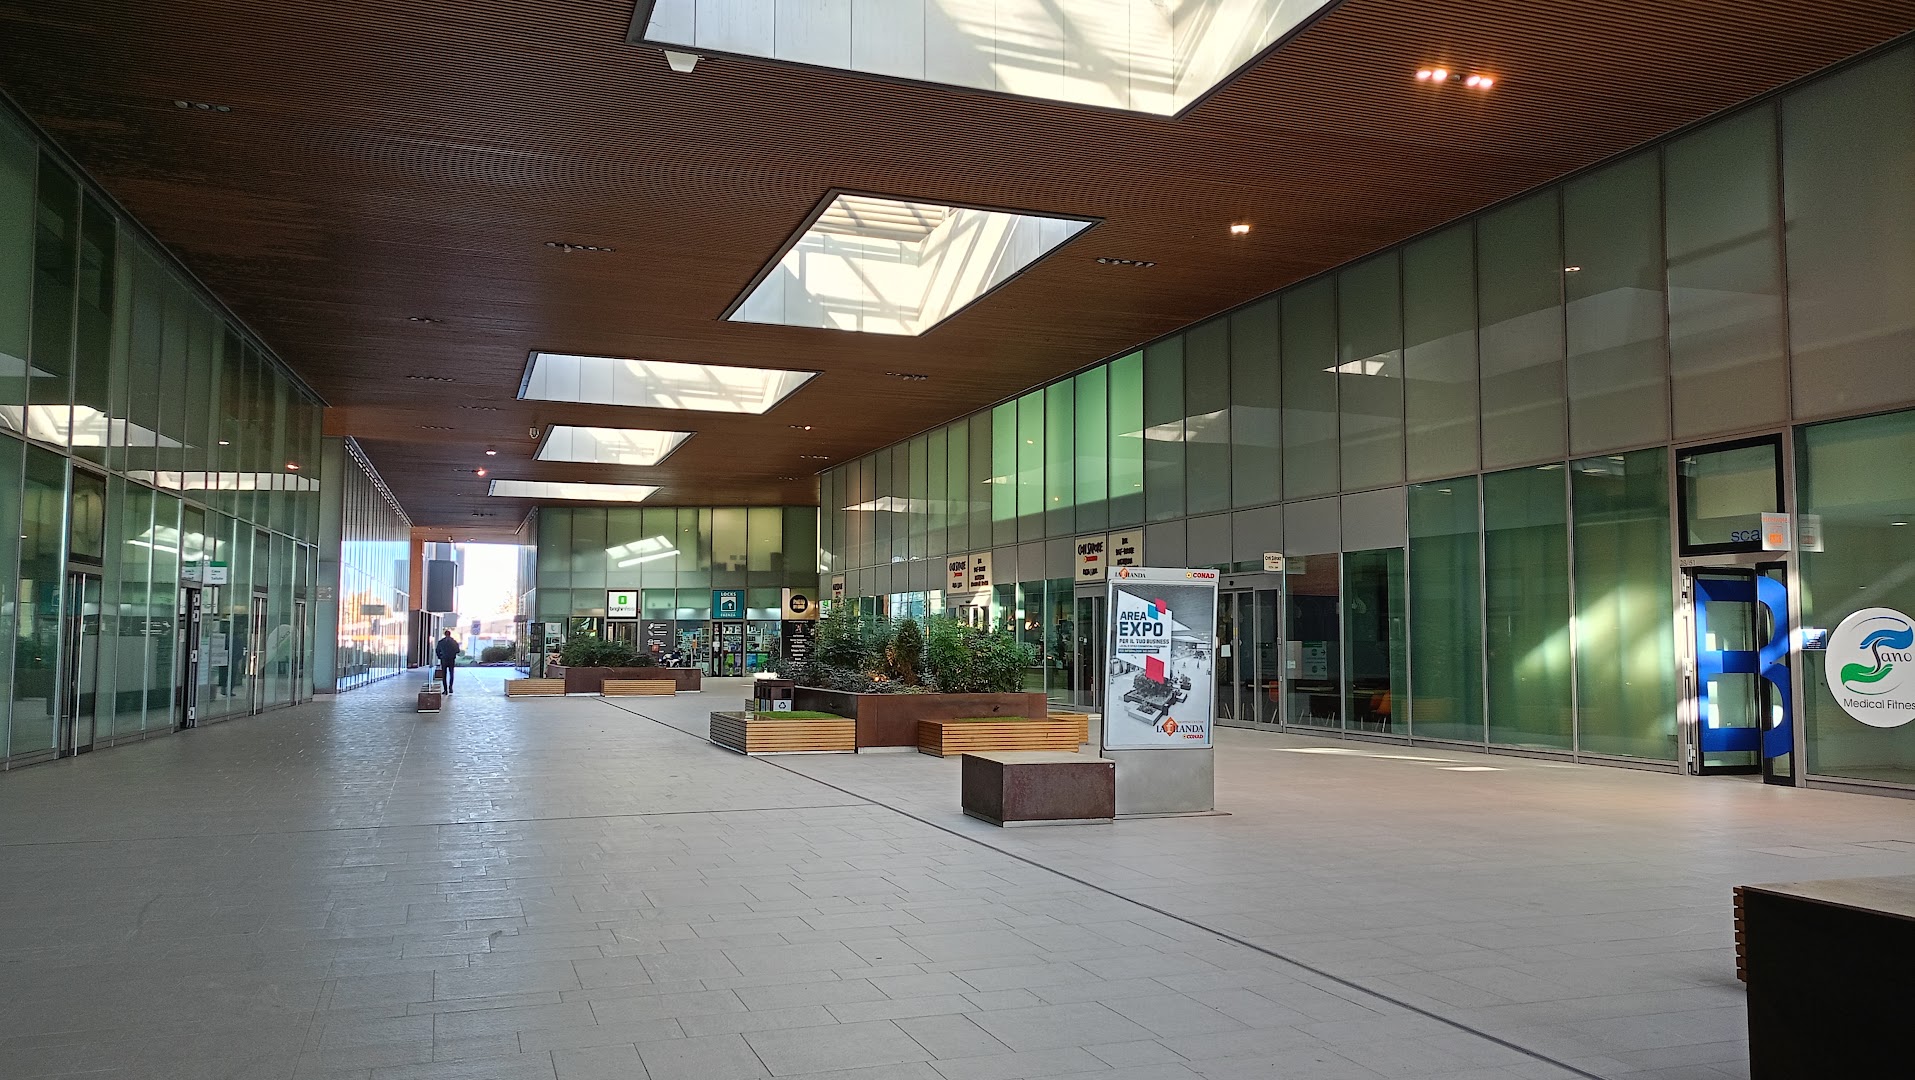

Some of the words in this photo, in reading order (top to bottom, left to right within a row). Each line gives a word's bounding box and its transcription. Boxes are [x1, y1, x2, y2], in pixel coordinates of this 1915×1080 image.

[1120, 611, 1147, 621] AREA
[1119, 621, 1164, 637] EXPO
[1843, 698, 1885, 709] Medical
